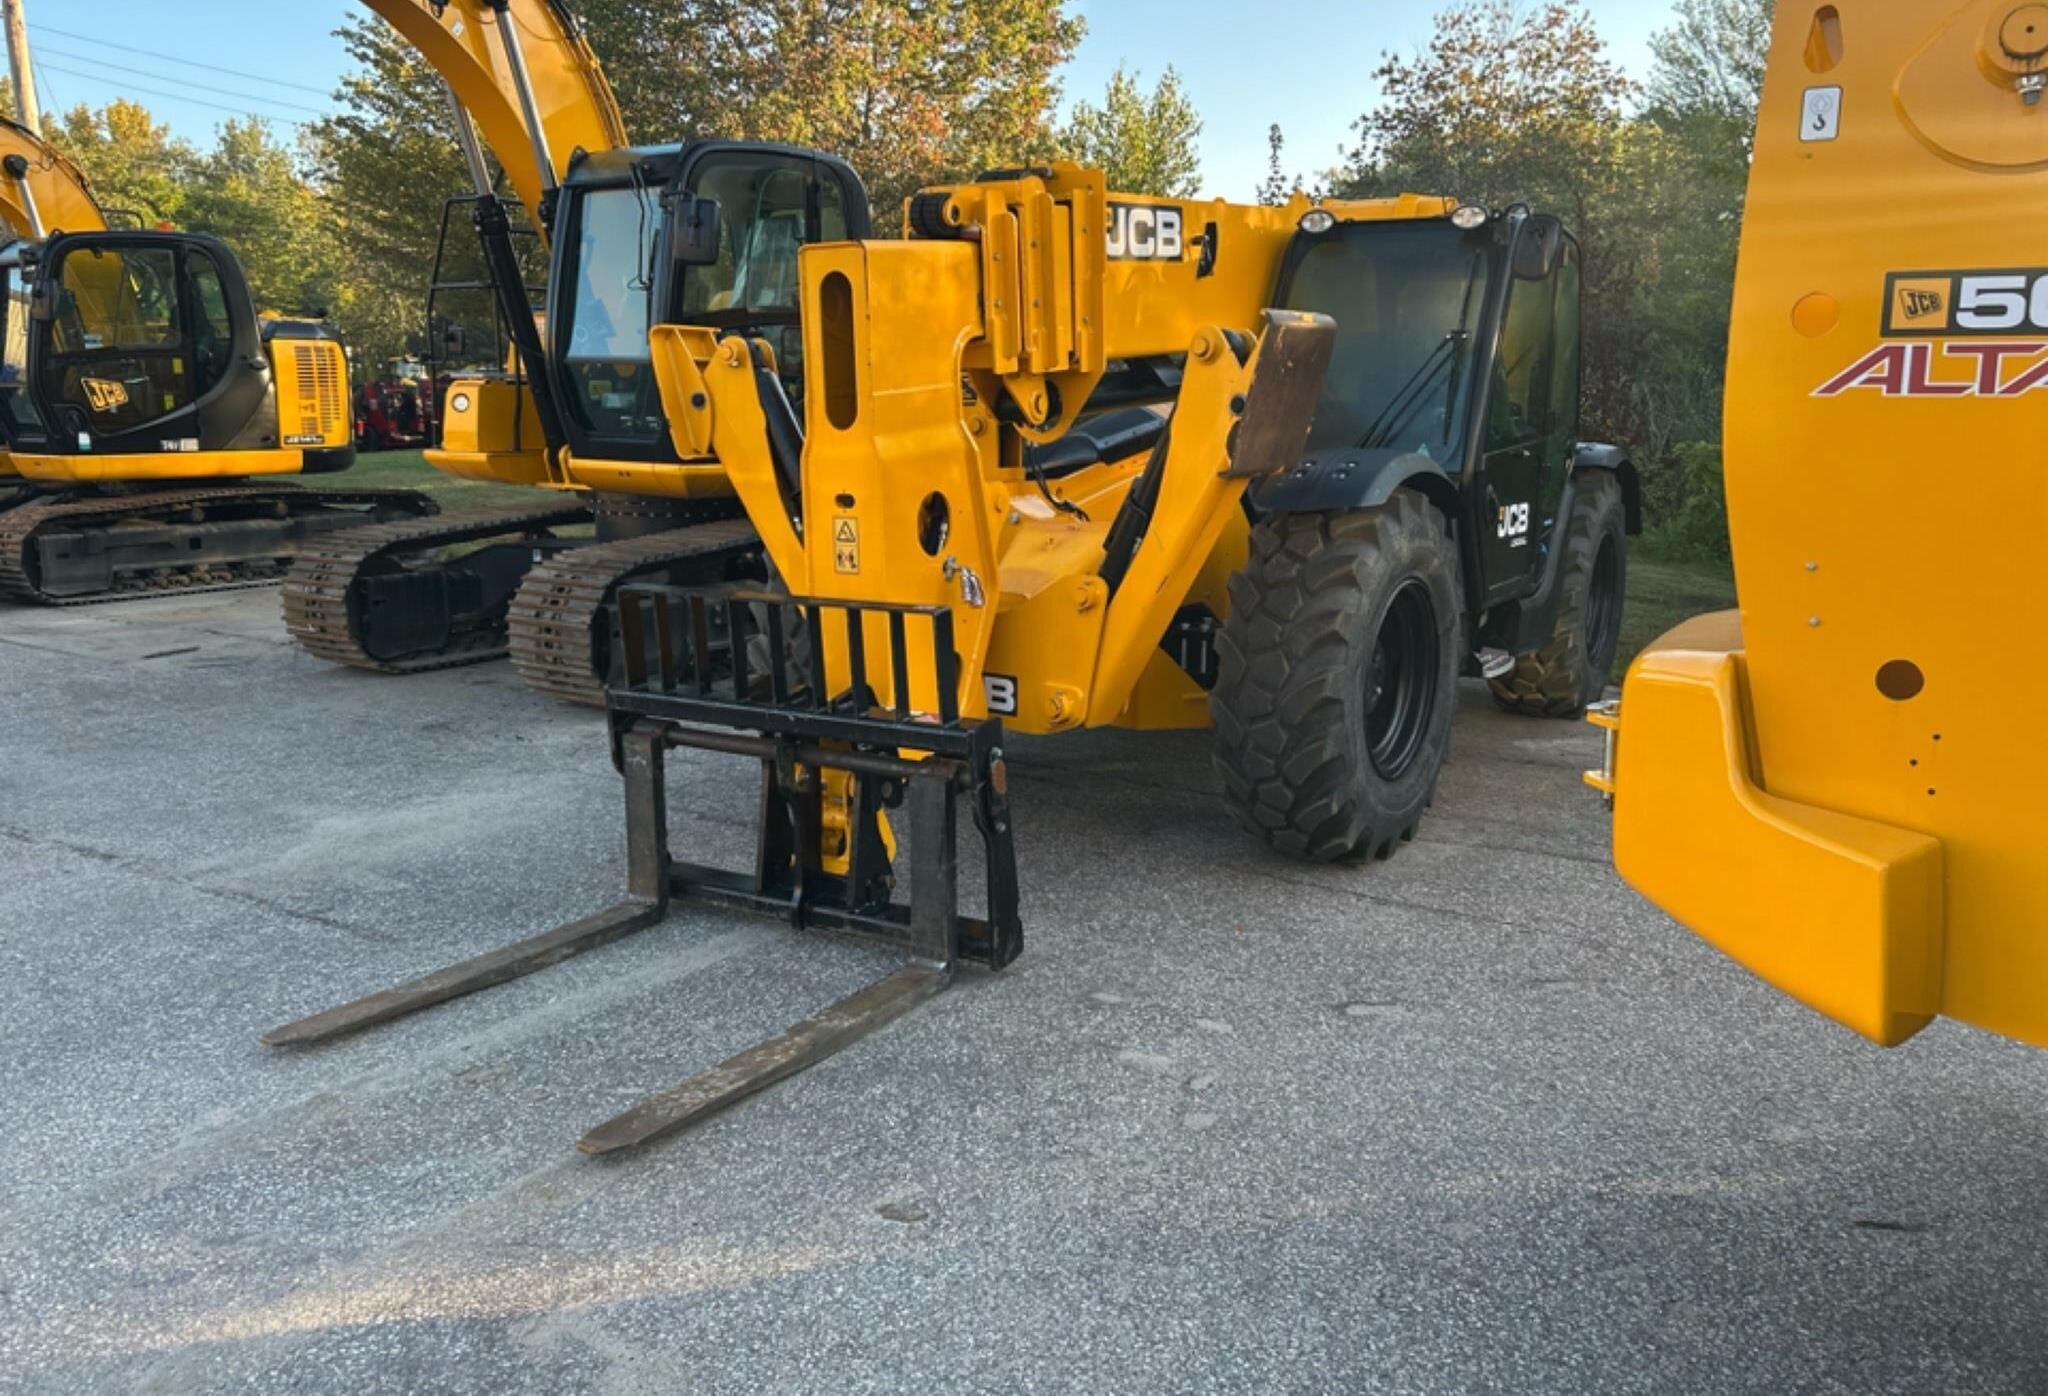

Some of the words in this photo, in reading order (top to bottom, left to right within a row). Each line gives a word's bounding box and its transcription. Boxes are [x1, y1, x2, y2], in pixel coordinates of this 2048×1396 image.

[1106, 206, 1182, 257] JCB
[1904, 290, 1942, 317] JCB
[85, 380, 127, 409] JCB
[1497, 502, 1528, 537] JCB
